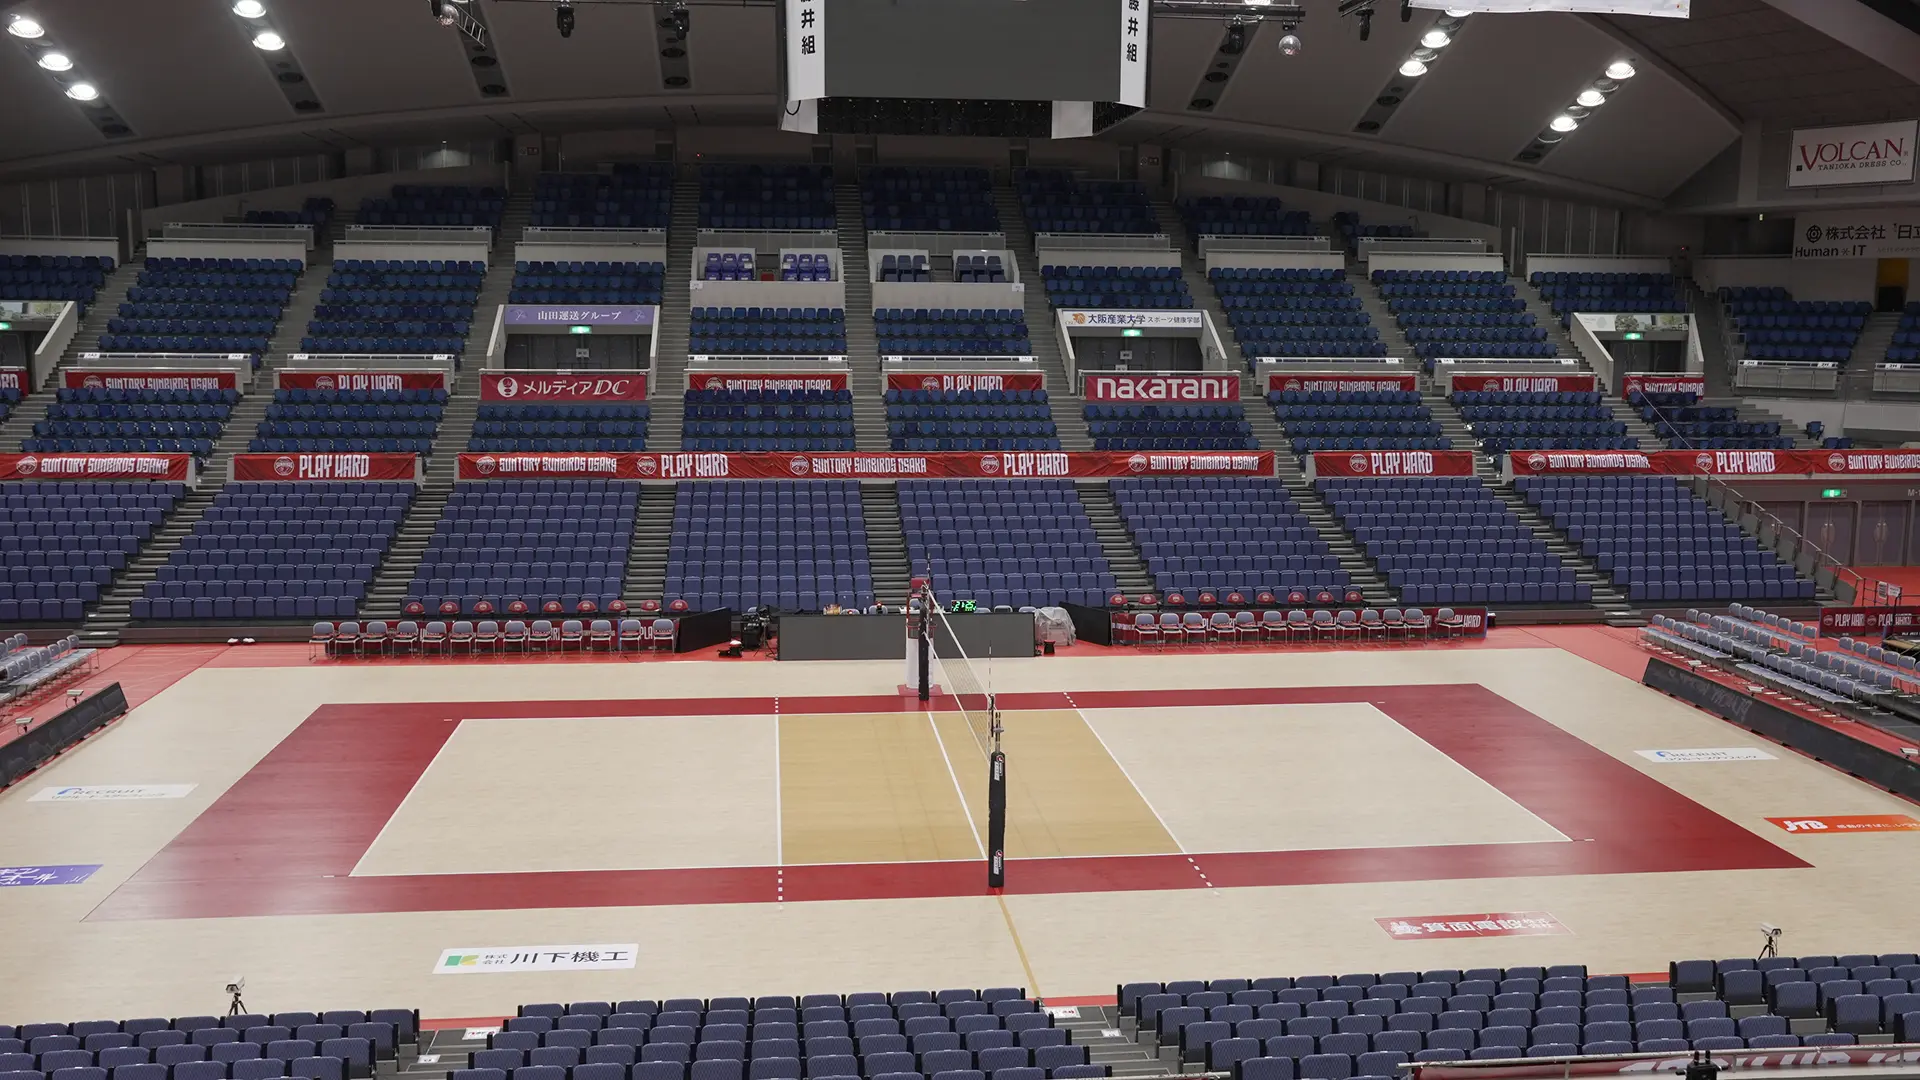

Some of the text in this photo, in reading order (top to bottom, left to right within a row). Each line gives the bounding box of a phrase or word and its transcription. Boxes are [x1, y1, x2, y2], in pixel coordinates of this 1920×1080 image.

[800, 0, 816, 55] 井組
[1799, 137, 1904, 171] VOLCAN
[1818, 162, 1856, 171] TANIOKA
[1859, 161, 1887, 169] DRESS
[1826, 224, 1886, 241] 株式会社
[1795, 246, 1839, 257] Human
[1852, 244, 1867, 256] IT
[537, 310, 622, 321] 山田運送グループ
[1088, 314, 1200, 325] 大阪産業大学 スポーツ健康学部
[40, 457, 170, 474] SUNTORY SUNBIRDS OSAKA
[299, 454, 370, 478] PLAY HARD
[499, 456, 617, 473] SUNTORY SUNBIRDS OSAKA
[660, 453, 728, 477] PLAY HARD
[812, 457, 927, 474] SUNTORY SUNBIRDS OSAKA
[1003, 453, 1069, 476] PLAY HARD
[1150, 455, 1259, 471] SUNTORY SUNBIRDS OSAKA
[1371, 451, 1433, 475] PLAY HARD
[1548, 453, 1650, 469] SUNTORY SUNBIRDS OSAKA
[1716, 451, 1776, 473] PLAY HARD
[1847, 454, 1883, 470] SUNTORY
[1783, 820, 1828, 832] JTB
[510, 950, 629, 964] 川下機工
